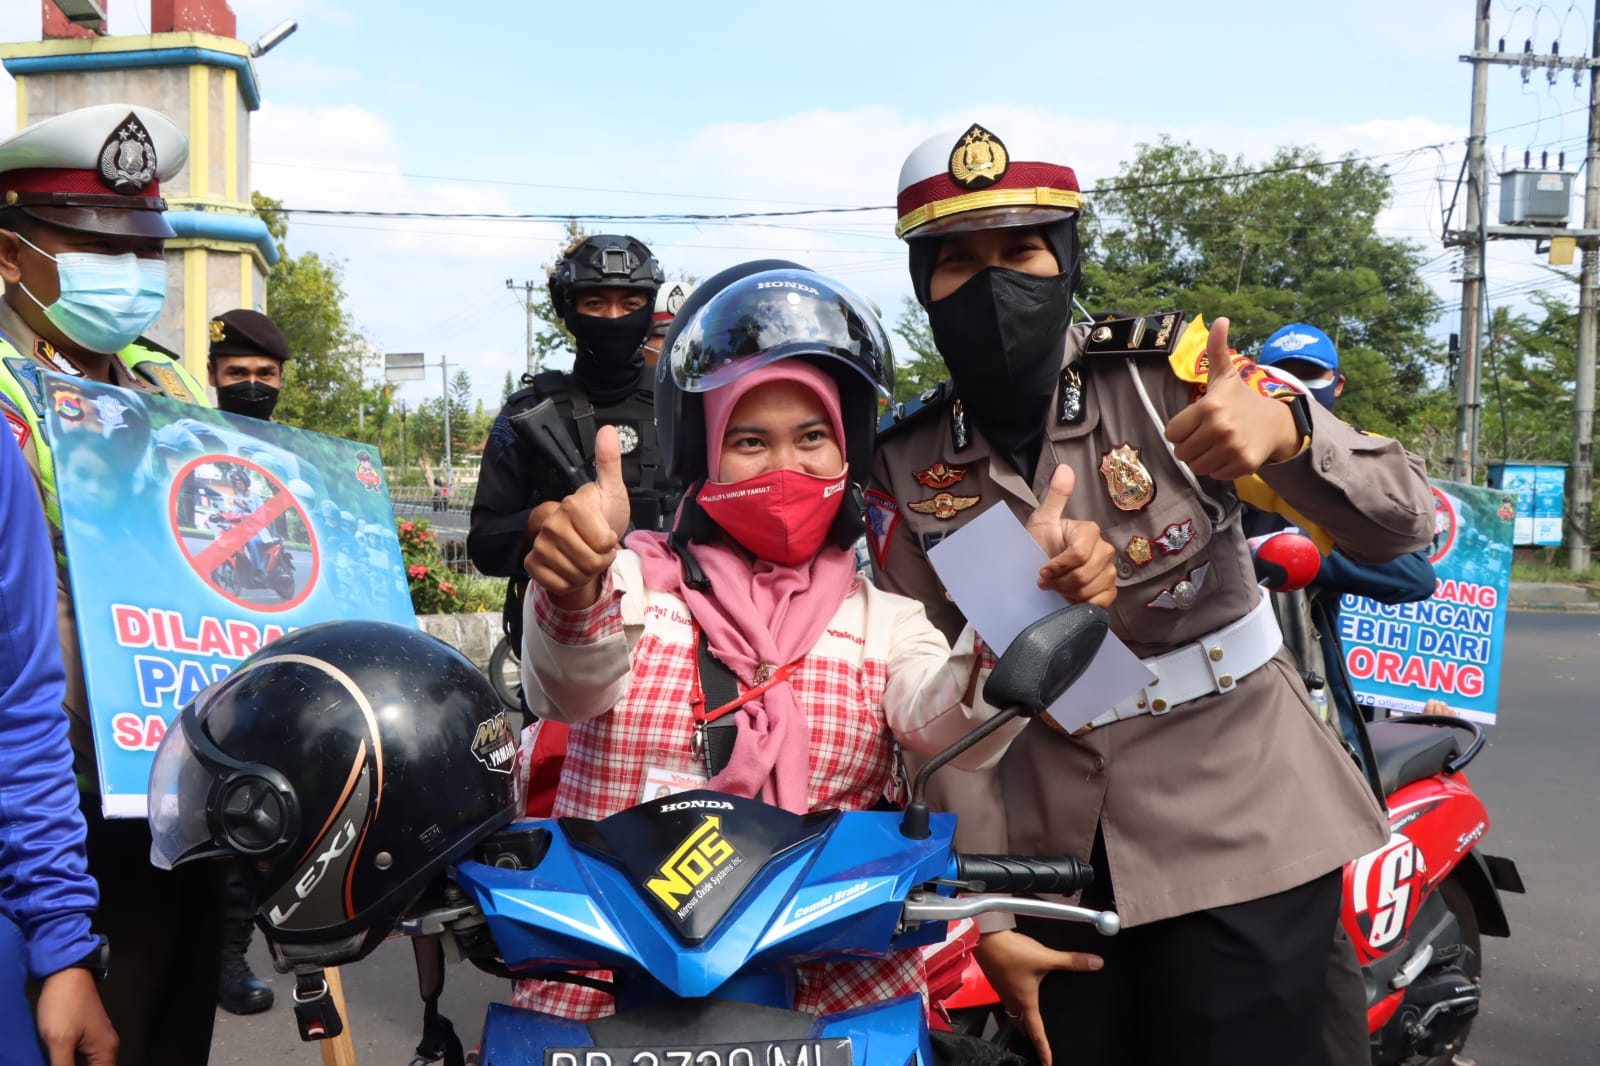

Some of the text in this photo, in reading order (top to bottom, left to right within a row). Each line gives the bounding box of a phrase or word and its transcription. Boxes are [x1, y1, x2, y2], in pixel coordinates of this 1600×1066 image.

[758, 281, 820, 296] HONDA
[746, 486, 772, 496] YAKULT
[1340, 593, 1493, 634] ONCENGAN
[1337, 612, 1491, 663] EBIH DARI
[1346, 646, 1484, 698] ORANG
[661, 800, 735, 813] HONDA
[646, 815, 735, 911] NOS
[677, 895, 700, 920] Nitrous
[695, 881, 714, 899] Oxide
[710, 863, 735, 886] Systems
[794, 881, 869, 919] Combi Brake
